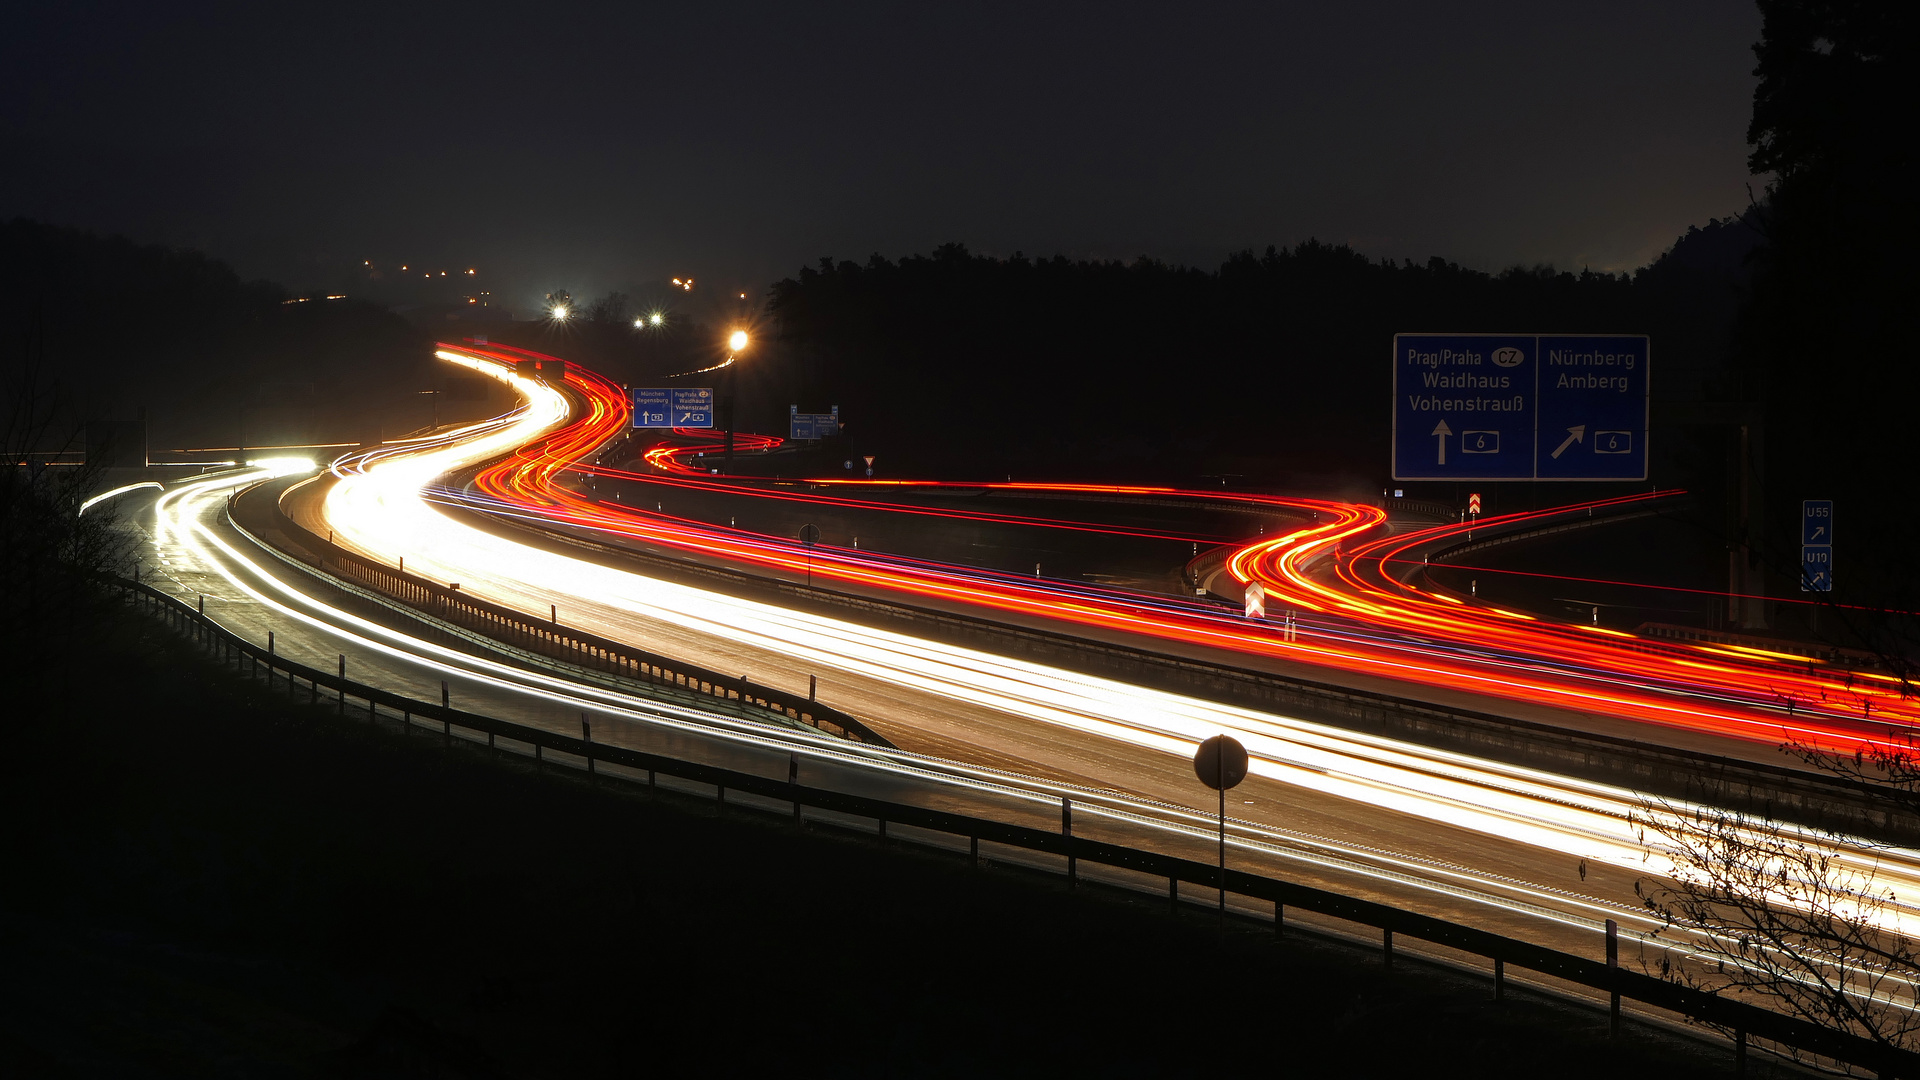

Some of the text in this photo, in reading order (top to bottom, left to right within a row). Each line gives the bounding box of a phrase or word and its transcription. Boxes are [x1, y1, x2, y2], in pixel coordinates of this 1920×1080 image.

[1408, 349, 1517, 369] Prag/Praha CZ
[1549, 349, 1635, 370] Nürnberg
[1423, 372, 1510, 388] Waidhaus
[1556, 373, 1628, 392] Amberg
[1409, 395, 1523, 411] Vohenstrauß
[1476, 435, 1485, 449] 6
[1608, 435, 1617, 449] 6
